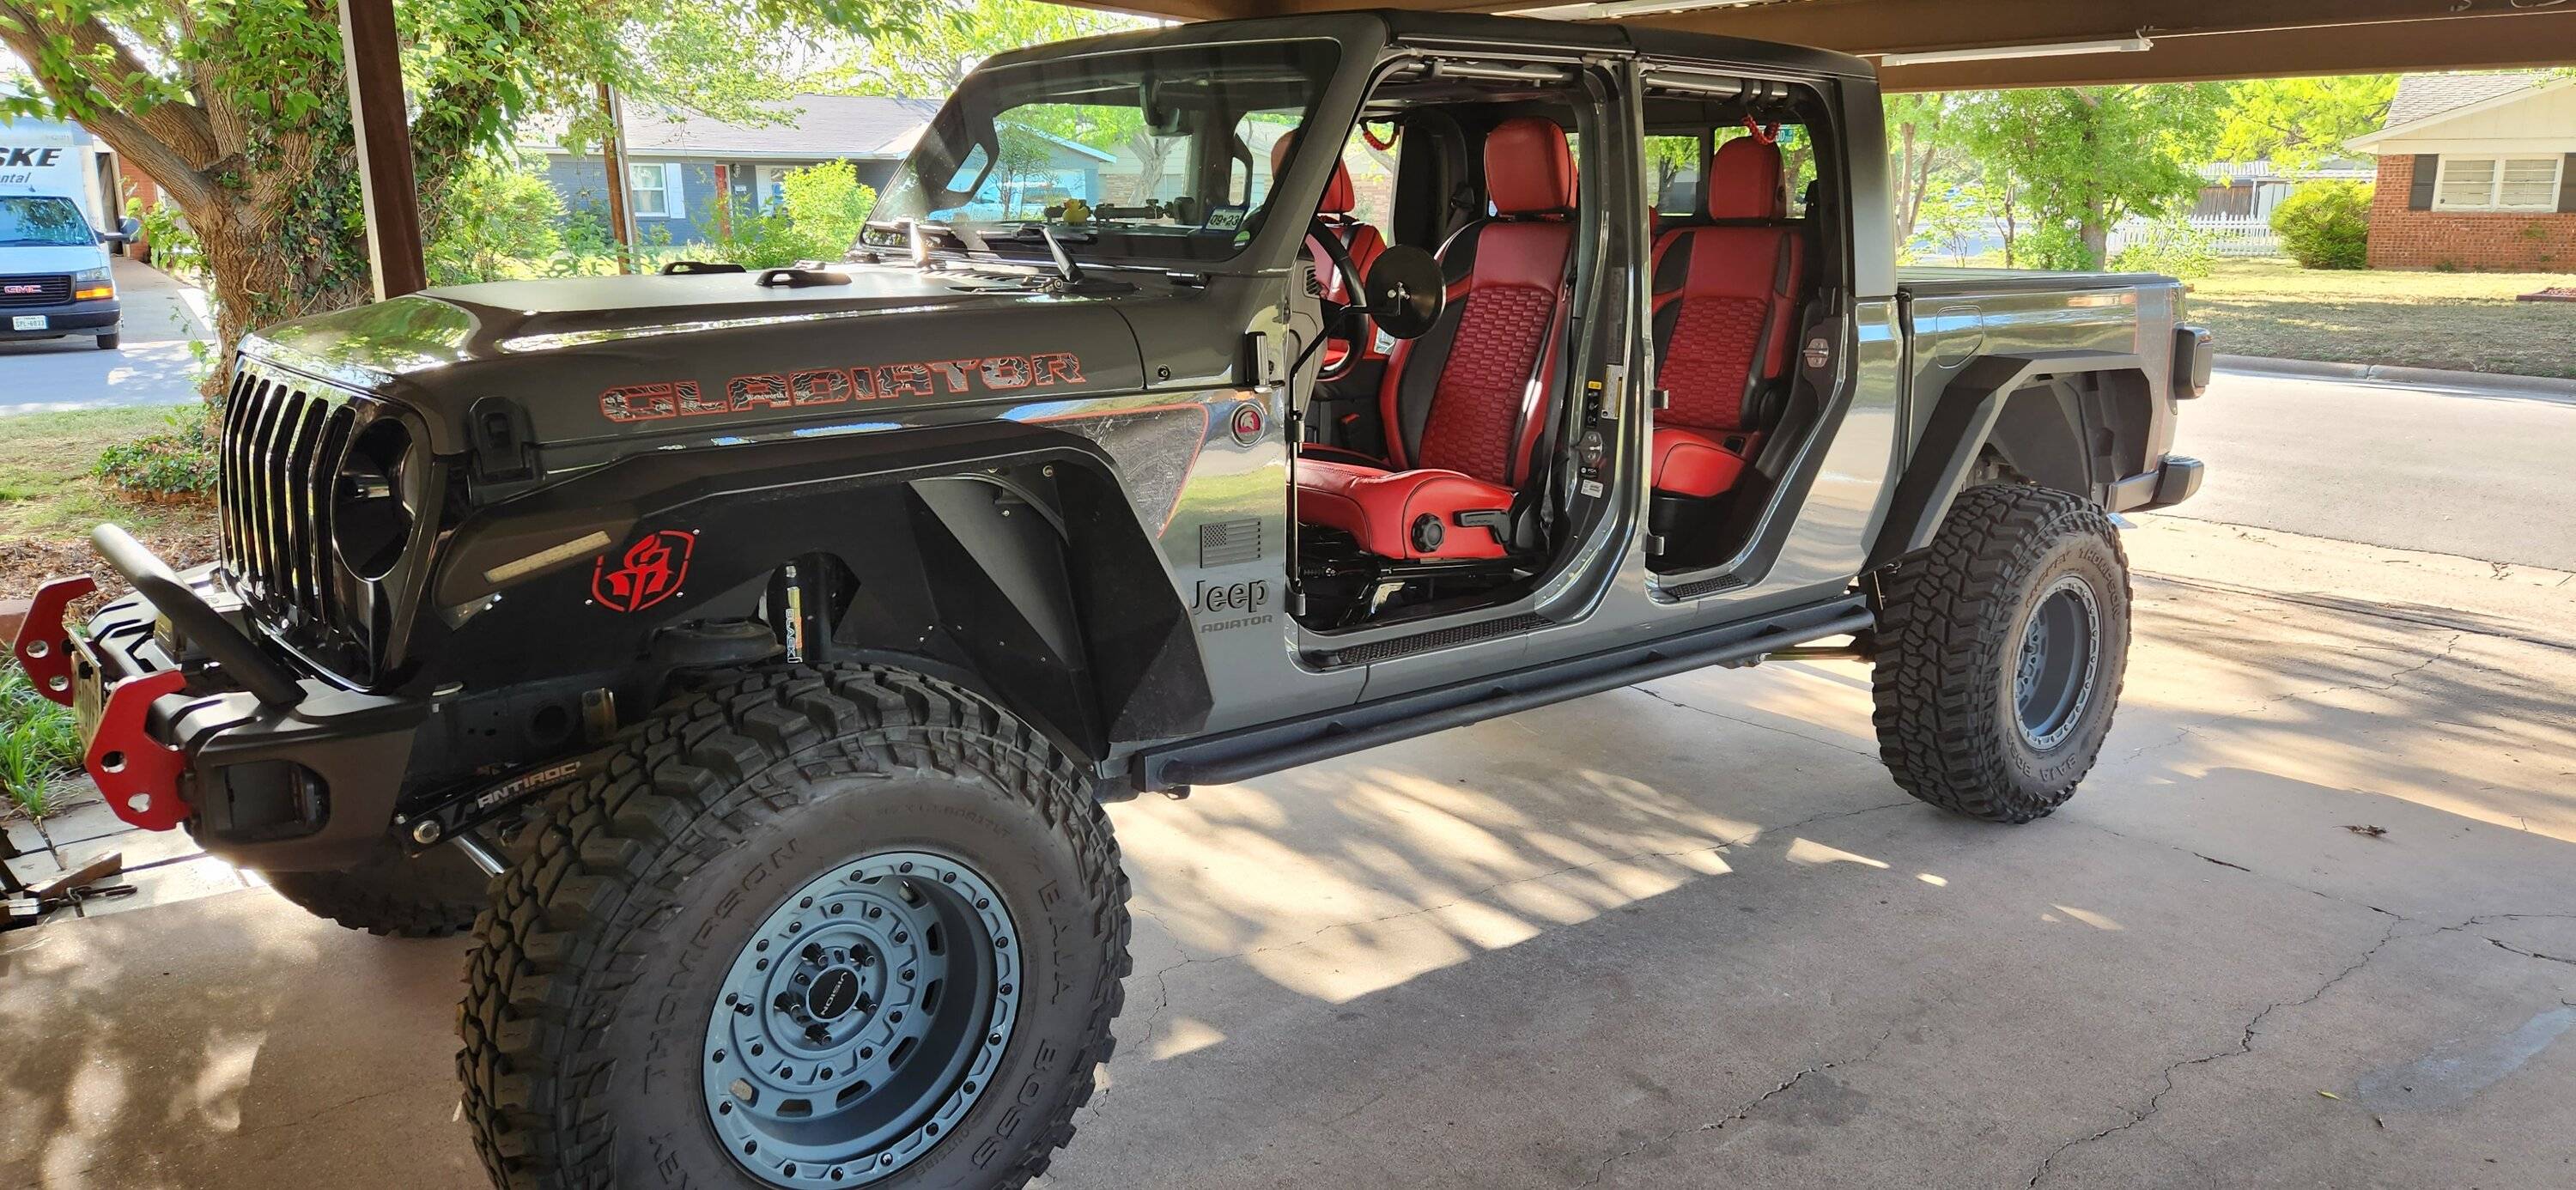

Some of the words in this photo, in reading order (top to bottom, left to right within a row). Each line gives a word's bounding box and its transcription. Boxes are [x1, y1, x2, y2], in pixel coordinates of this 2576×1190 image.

[4, 284, 42, 294] GMC
[599, 352, 1086, 422] GLADIATOR
[1192, 580, 1270, 616] Jeep
[786, 608, 796, 659] BLACK
[1201, 614, 1273, 634] ADIATOR
[477, 761, 580, 809] ANTIROC
[821, 972, 848, 1016] VISION
[971, 1038, 1057, 1170] BOSS
